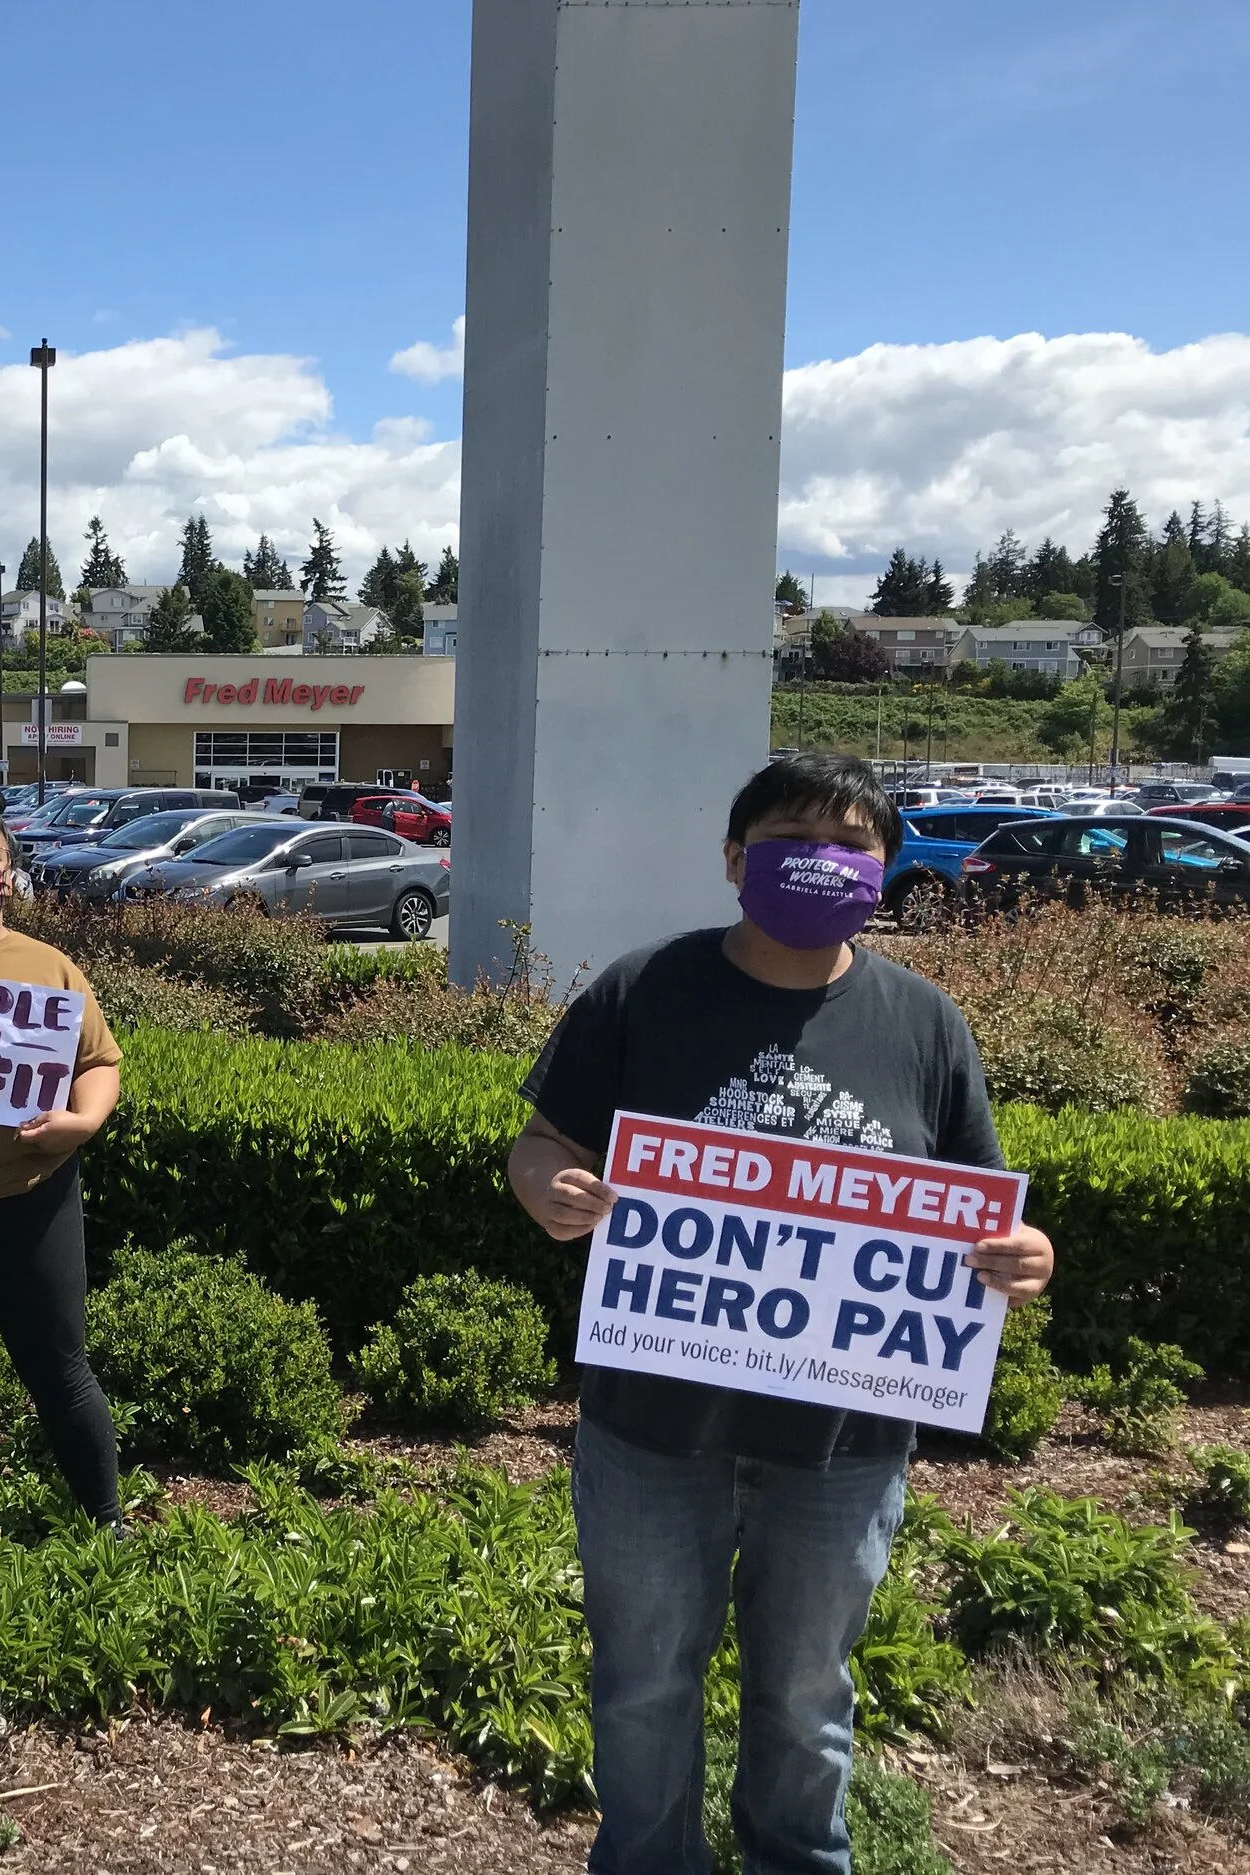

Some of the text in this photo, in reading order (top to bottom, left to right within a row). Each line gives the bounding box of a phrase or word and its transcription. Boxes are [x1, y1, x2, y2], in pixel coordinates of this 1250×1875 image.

[184, 678, 366, 711] Fred Meyer
[780, 857, 860, 881] PROTECT ALL
[789, 870, 846, 888] WORKERS
[779, 882, 853, 898] GABRIELA SEATTLE
[753, 1072, 784, 1085] LOVE
[719, 1086, 784, 1106] HOODSTOCK
[710, 1097, 762, 1112] SOMMET
[763, 1103, 796, 1117] NOIR
[832, 1099, 864, 1113] CISME
[693, 1111, 755, 1130] ATELIERS
[781, 1117, 795, 1127] ET
[816, 1118, 861, 1129] MIQUE
[812, 1134, 841, 1143] NATION
[860, 1133, 894, 1148] POLICE
[626, 1133, 1001, 1231] FRED MEYER:
[606, 1197, 836, 1281] DON'T
[600, 1258, 986, 1372] HERO PAY
[589, 1320, 968, 1410] Add your voice: bit.ly/MessageKroger
